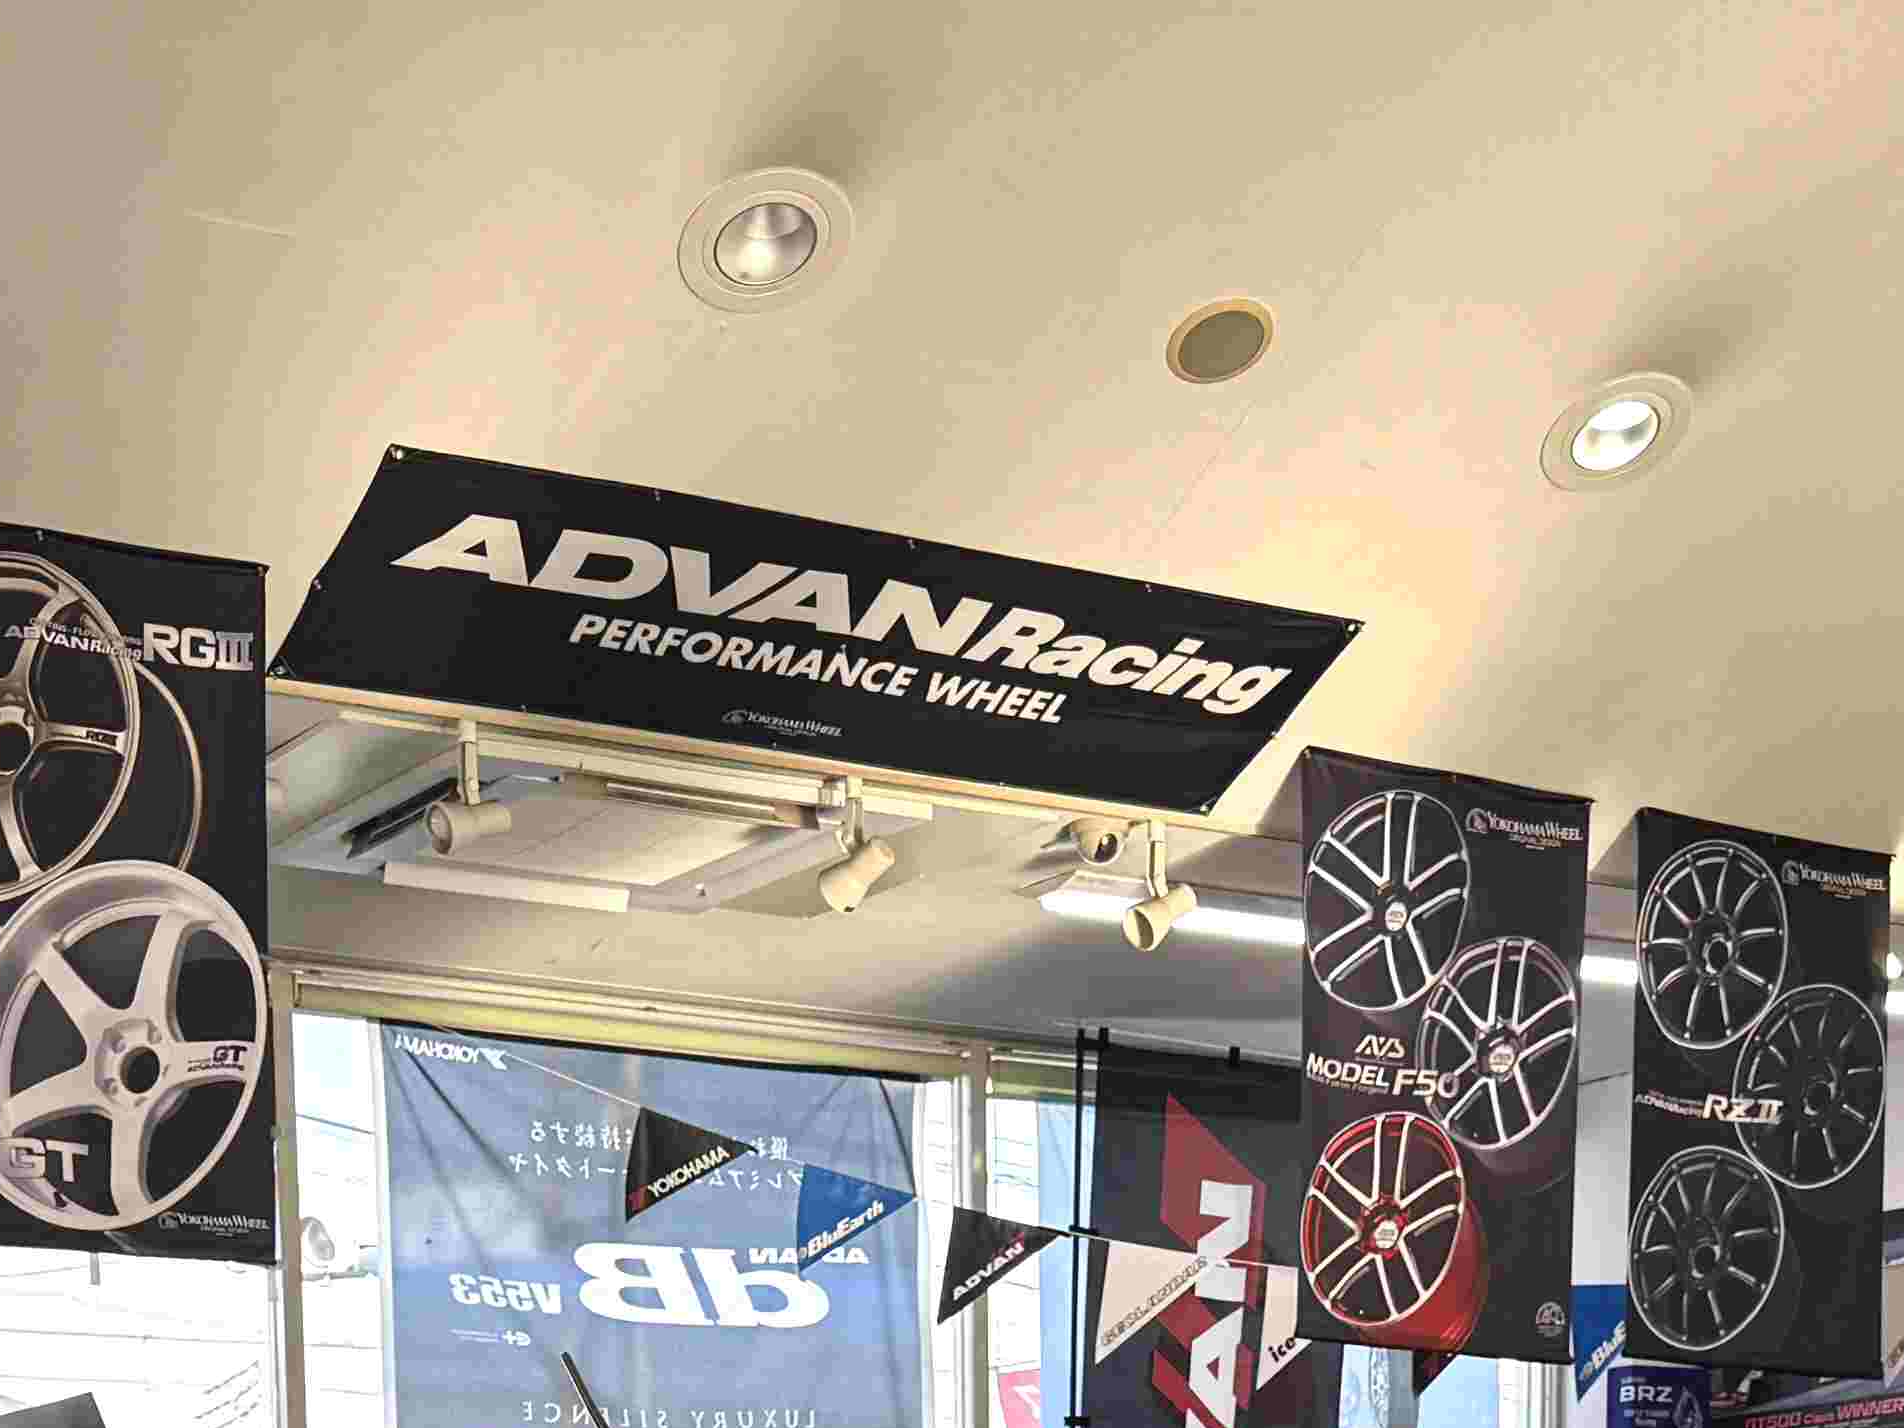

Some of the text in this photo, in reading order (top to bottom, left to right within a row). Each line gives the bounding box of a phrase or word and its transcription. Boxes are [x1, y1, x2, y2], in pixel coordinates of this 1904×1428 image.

[567, 612, 1068, 729] PERFORMANCE WHEEL
[1306, 1052, 1390, 1088] MODEL
[1392, 1069, 1460, 1099] F50
[647, 1144, 731, 1198] YOKOHAMA
[807, 1198, 886, 1257] BlueEarth
[951, 1240, 1025, 1303] ADVAN
[1619, 1385, 1673, 1403] BRZ
